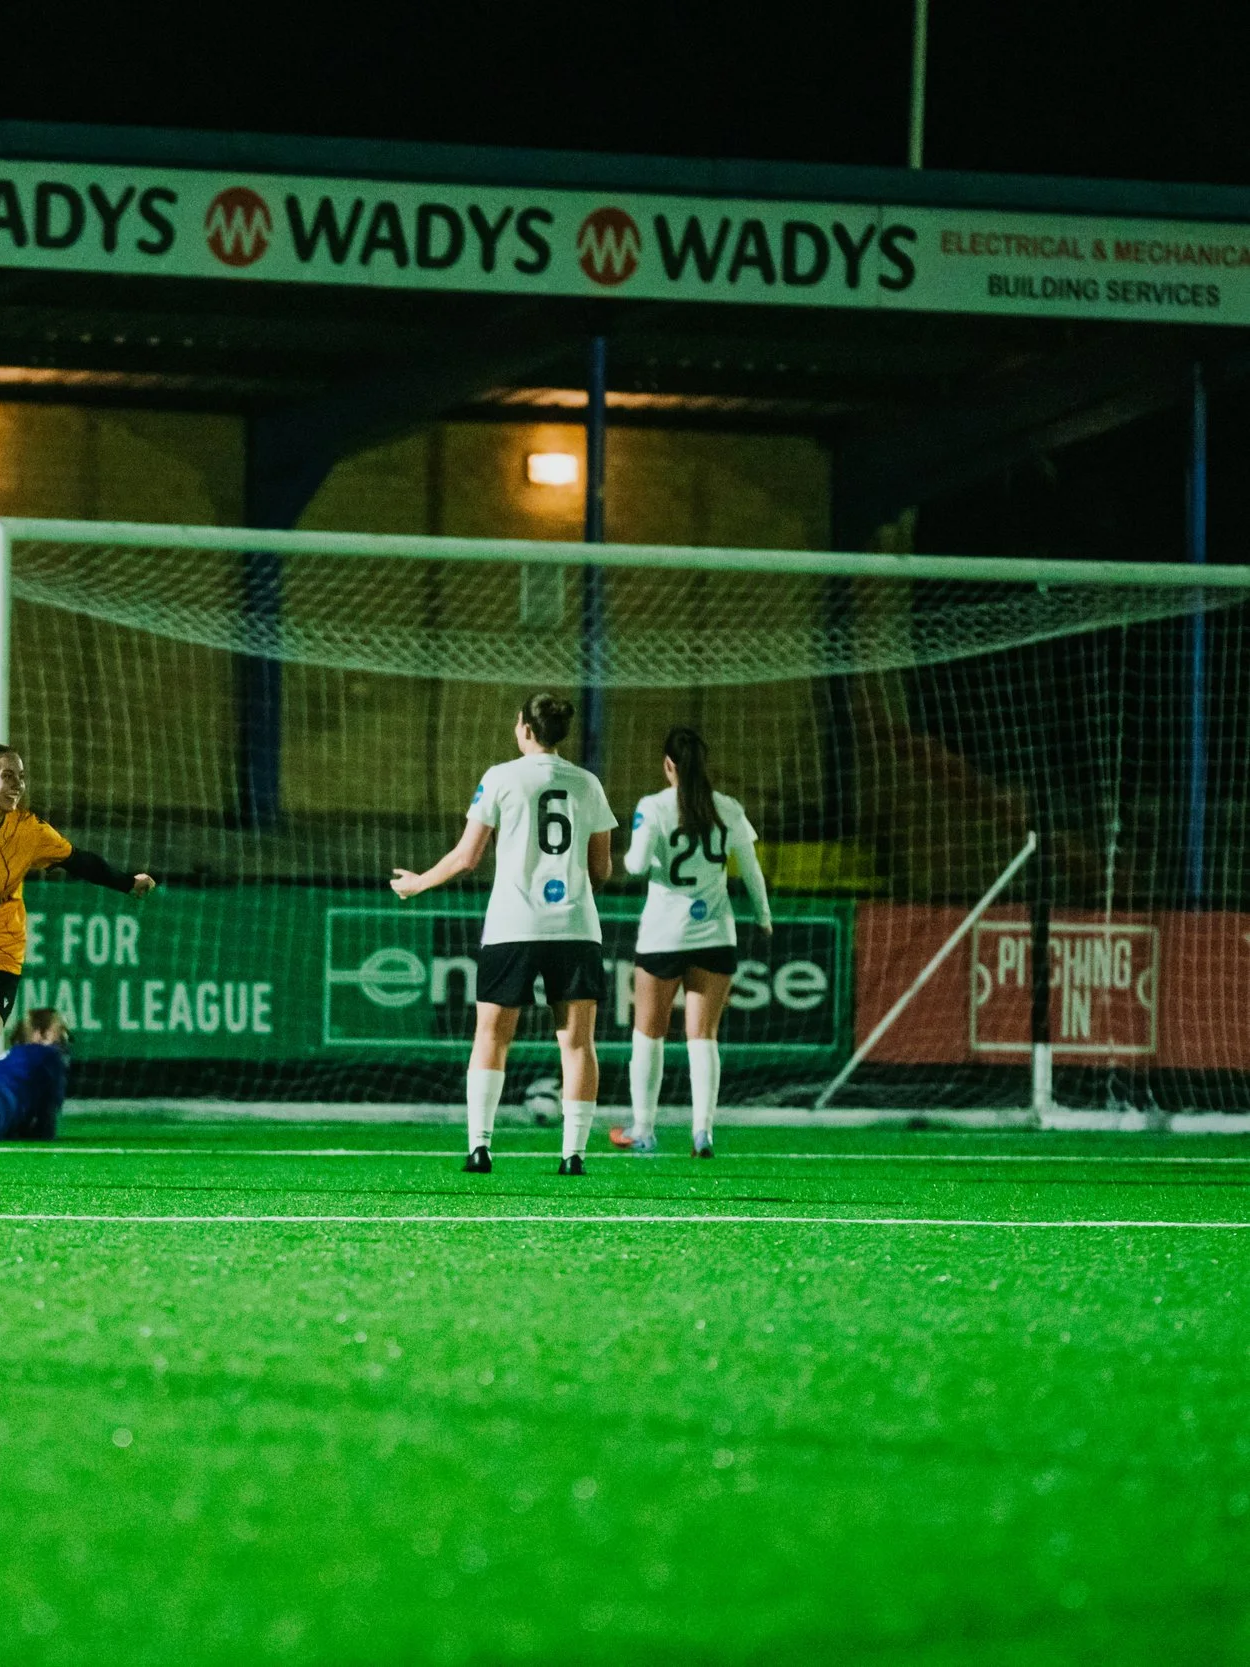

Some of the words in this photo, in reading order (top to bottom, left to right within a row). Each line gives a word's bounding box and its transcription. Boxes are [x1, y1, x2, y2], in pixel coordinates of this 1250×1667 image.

[284, 194, 554, 276] WADYS
[653, 214, 917, 292] WADYS
[940, 229, 1084, 261] ELECTRICAL
[1093, 238, 1107, 261] &
[987, 273, 1099, 301] BUILDING
[1105, 280, 1221, 307] SERVICES
[537, 789, 573, 855] 6
[62, 914, 140, 965] FOR
[998, 936, 1132, 990] PICHING
[118, 980, 273, 1034] LEAGUE
